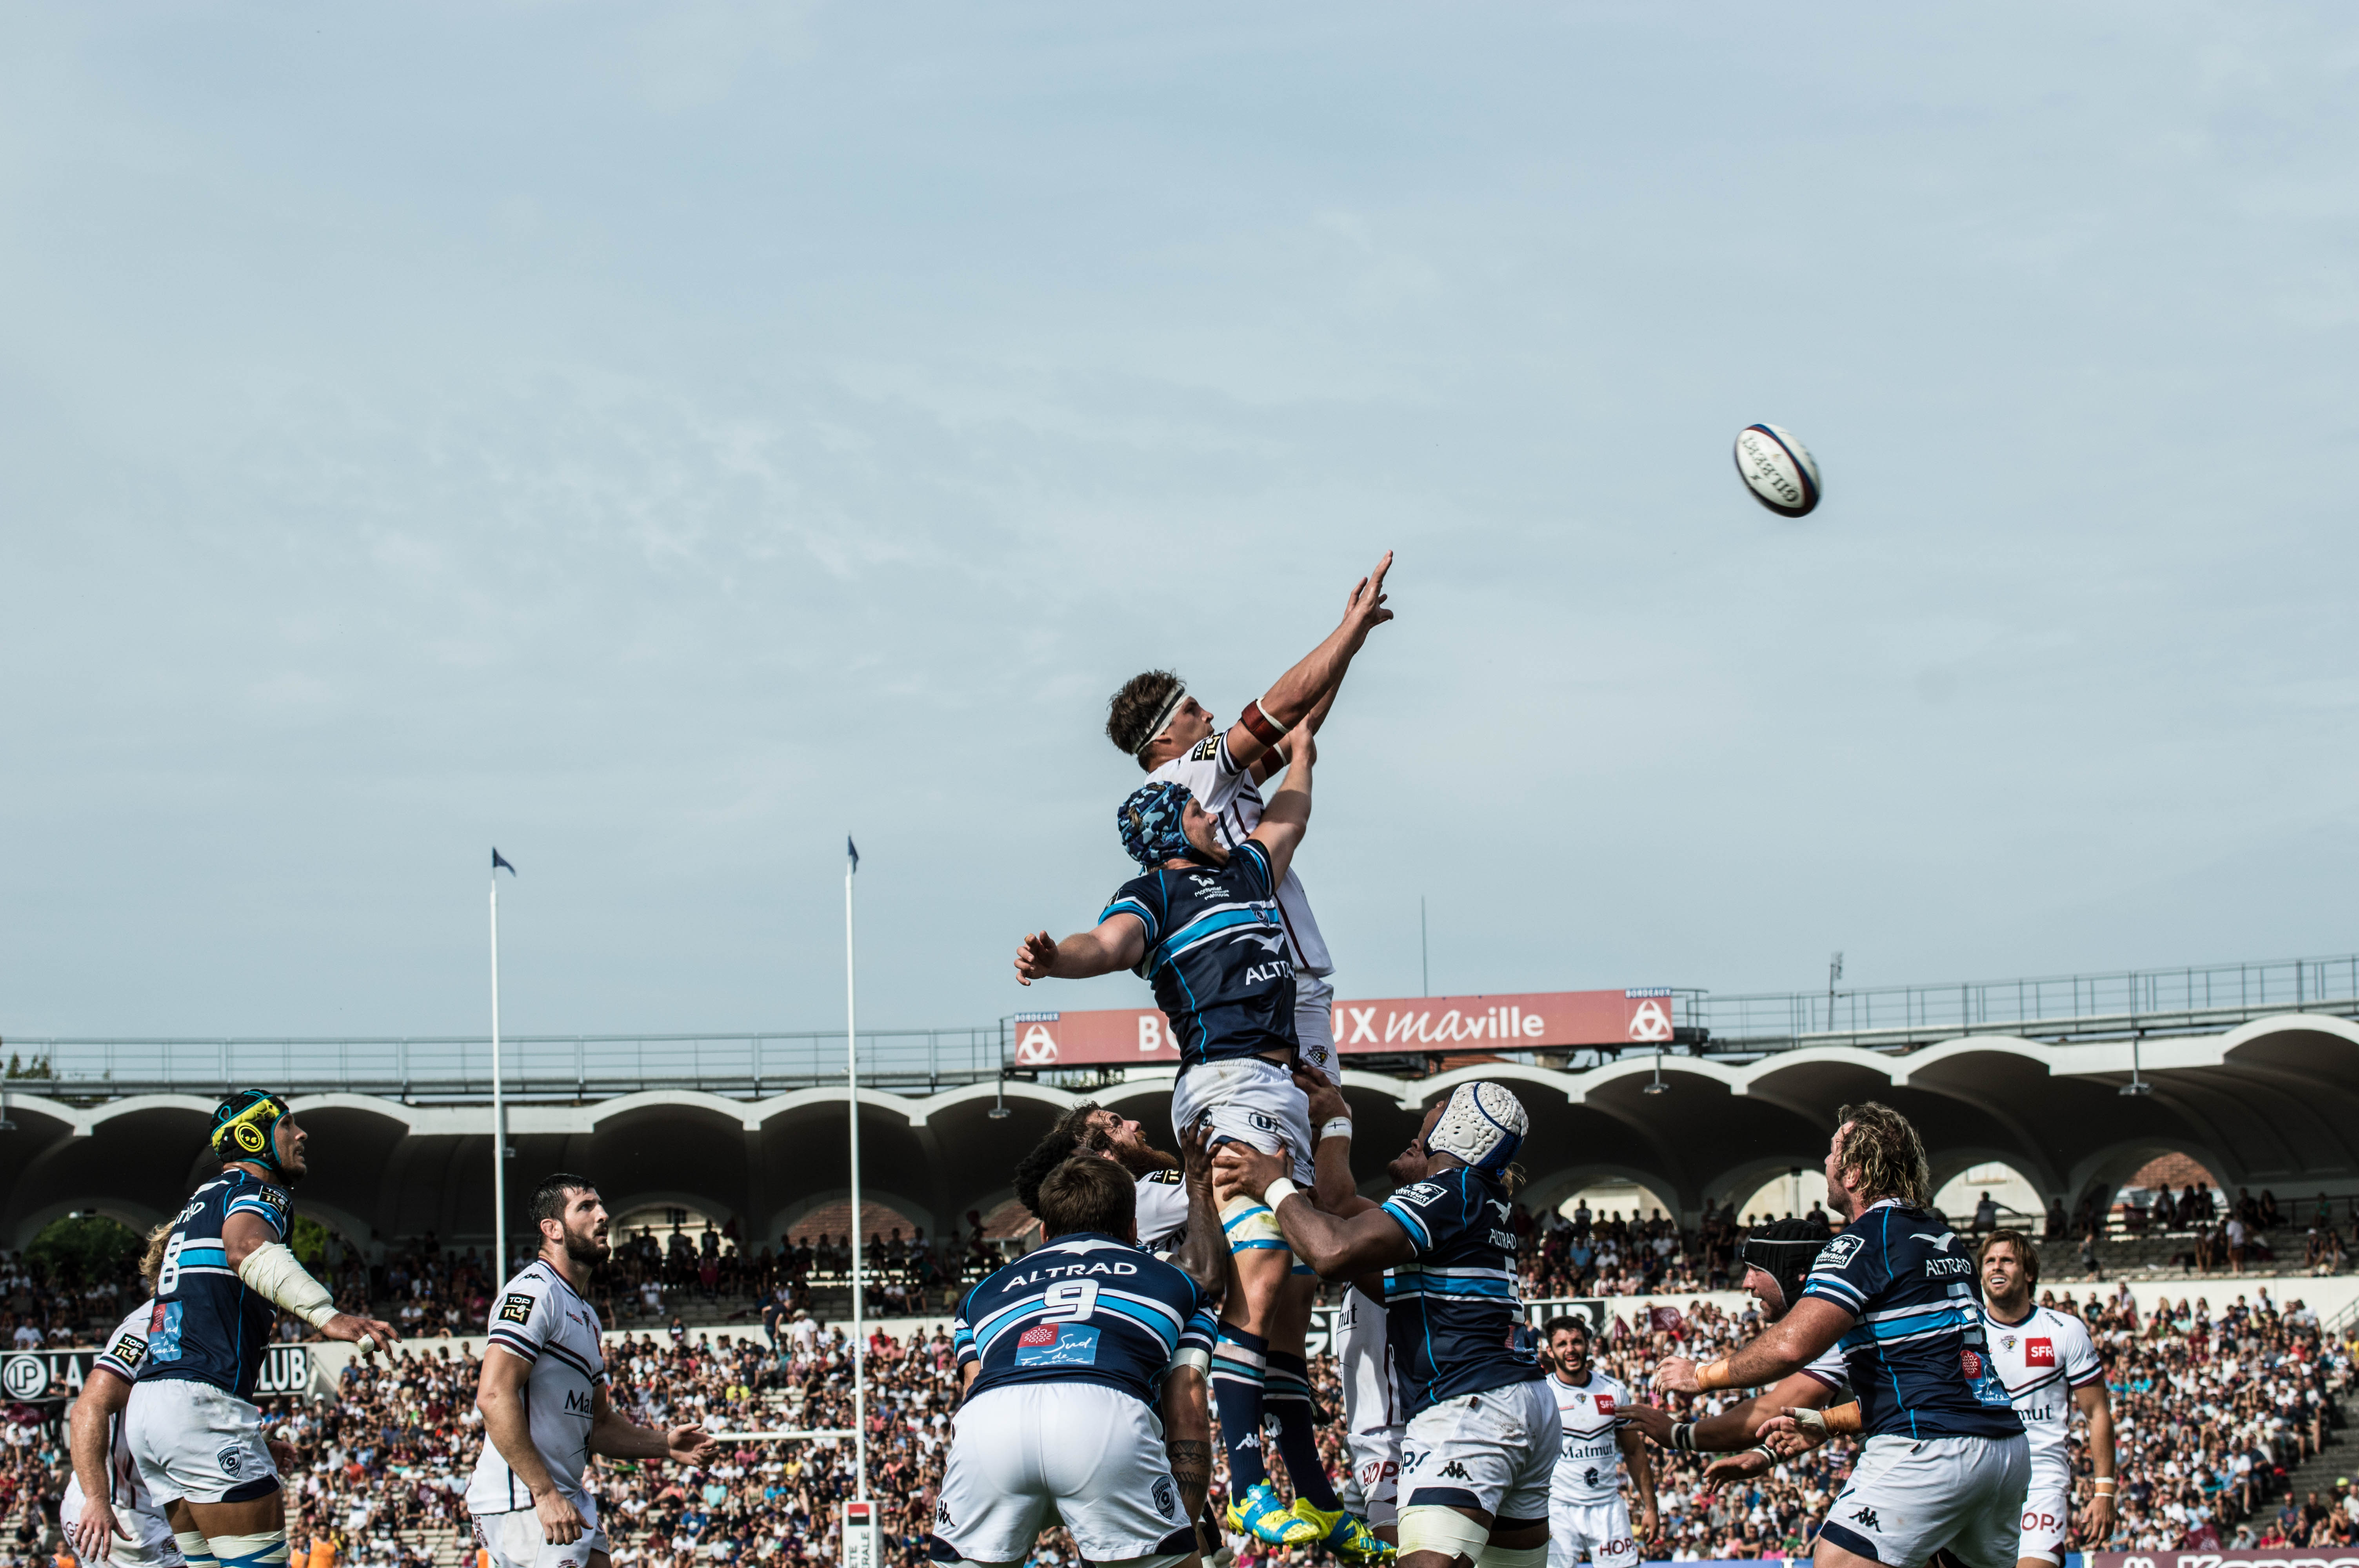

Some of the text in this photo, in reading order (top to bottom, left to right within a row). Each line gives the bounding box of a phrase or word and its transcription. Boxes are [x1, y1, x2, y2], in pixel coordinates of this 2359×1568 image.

[1742, 436, 1799, 503] GILBERT
[1625, 989, 1671, 998] BORDEAUX
[1014, 1013, 1059, 1022] BORDEAUX
[265, 1195, 284, 1212] 14
[266, 1187, 288, 1202] TOP
[1488, 1228, 1517, 1250] ALTRAD
[158, 1231, 185, 1296] 8
[1926, 1258, 1972, 1277] ALTRAD
[1001, 1262, 1138, 1292] ALTRAD
[1504, 1255, 1525, 1324] 5
[1040, 1278, 1099, 1324] 9
[504, 1308, 525, 1321] 14
[160, 1316, 179, 1339] Sud
[124, 1336, 144, 1349] TOP
[1041, 1334, 1092, 1353] Sud
[2031, 1346, 2054, 1357] SFR
[115, 1348, 136, 1364] 14
[1020, 1356, 1090, 1366] France
[256, 1348, 307, 1392] LUB
[1562, 1443, 1613, 1459] Matmut
